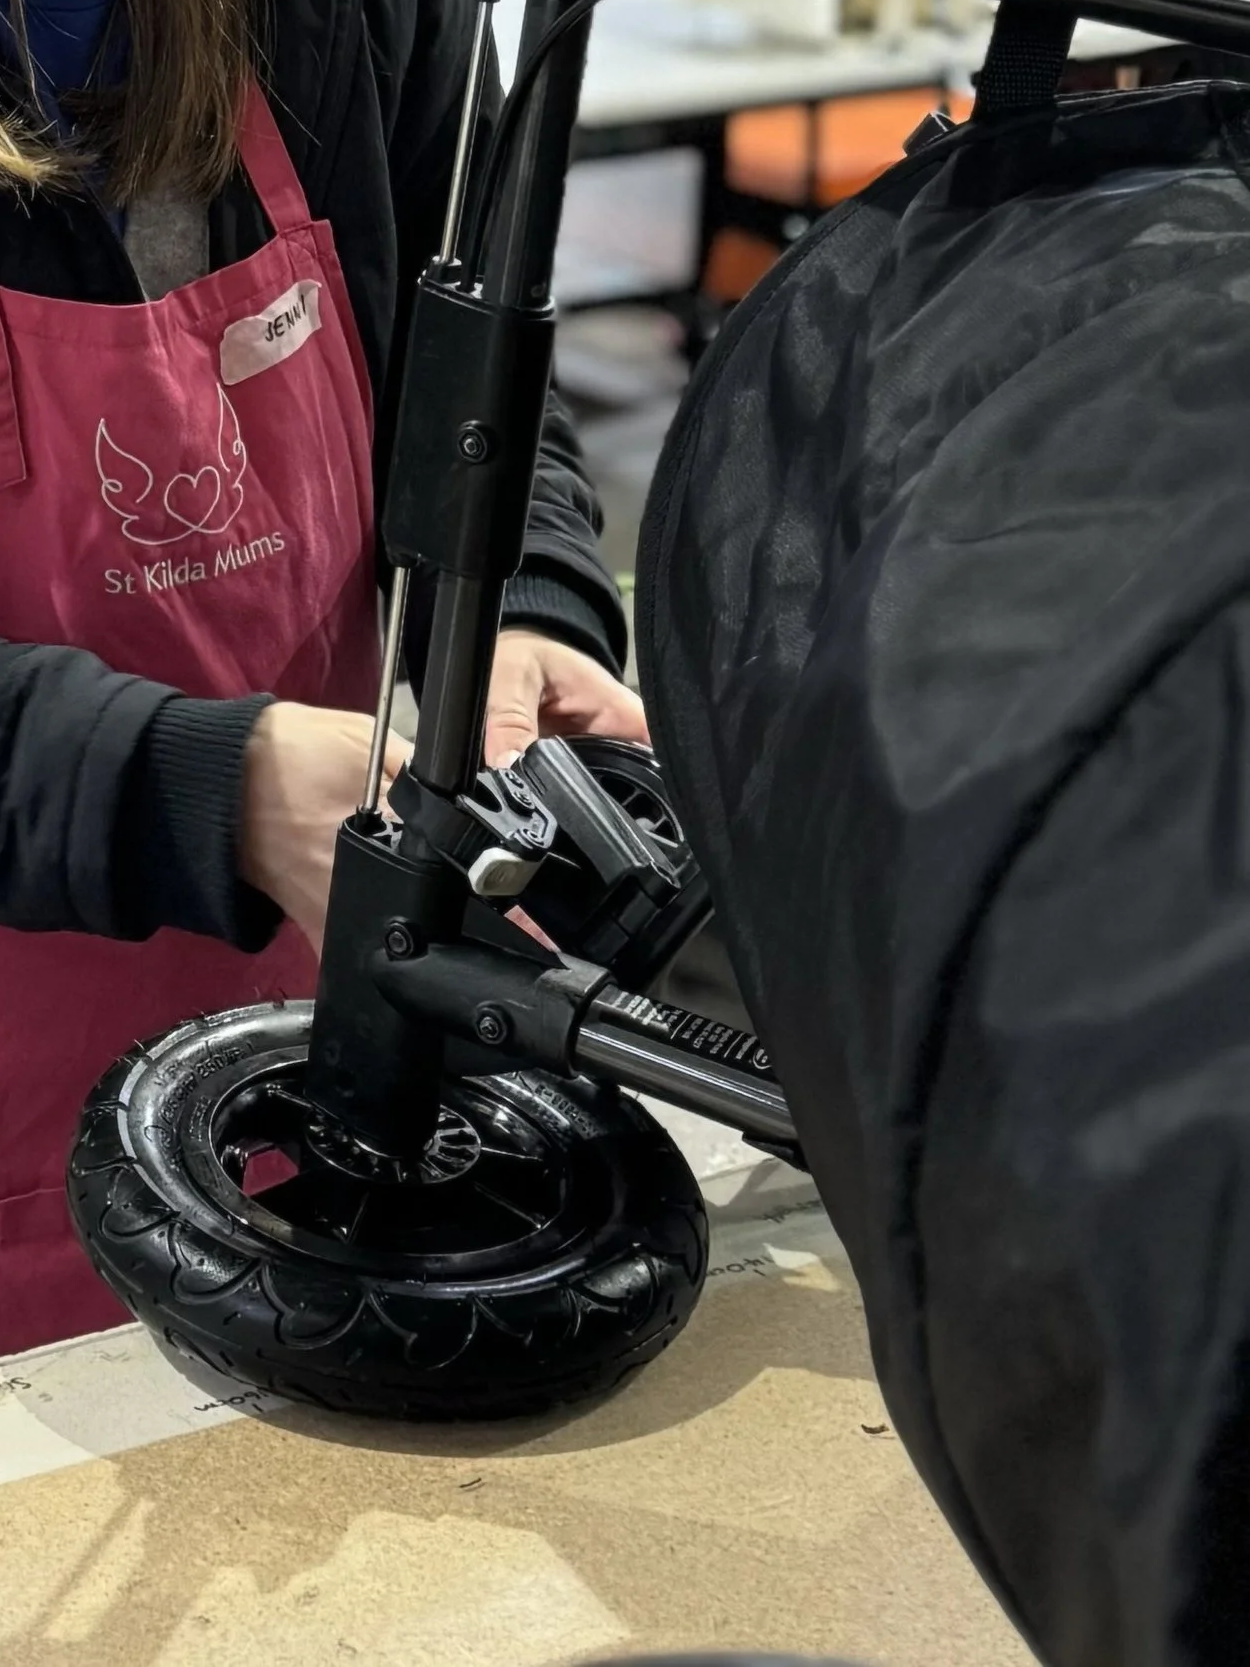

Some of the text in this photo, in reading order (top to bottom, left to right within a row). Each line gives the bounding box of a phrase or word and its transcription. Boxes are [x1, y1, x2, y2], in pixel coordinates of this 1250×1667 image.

[104, 531, 286, 595] St Kilda Mums
[706, 1255, 775, 1277] 140c
